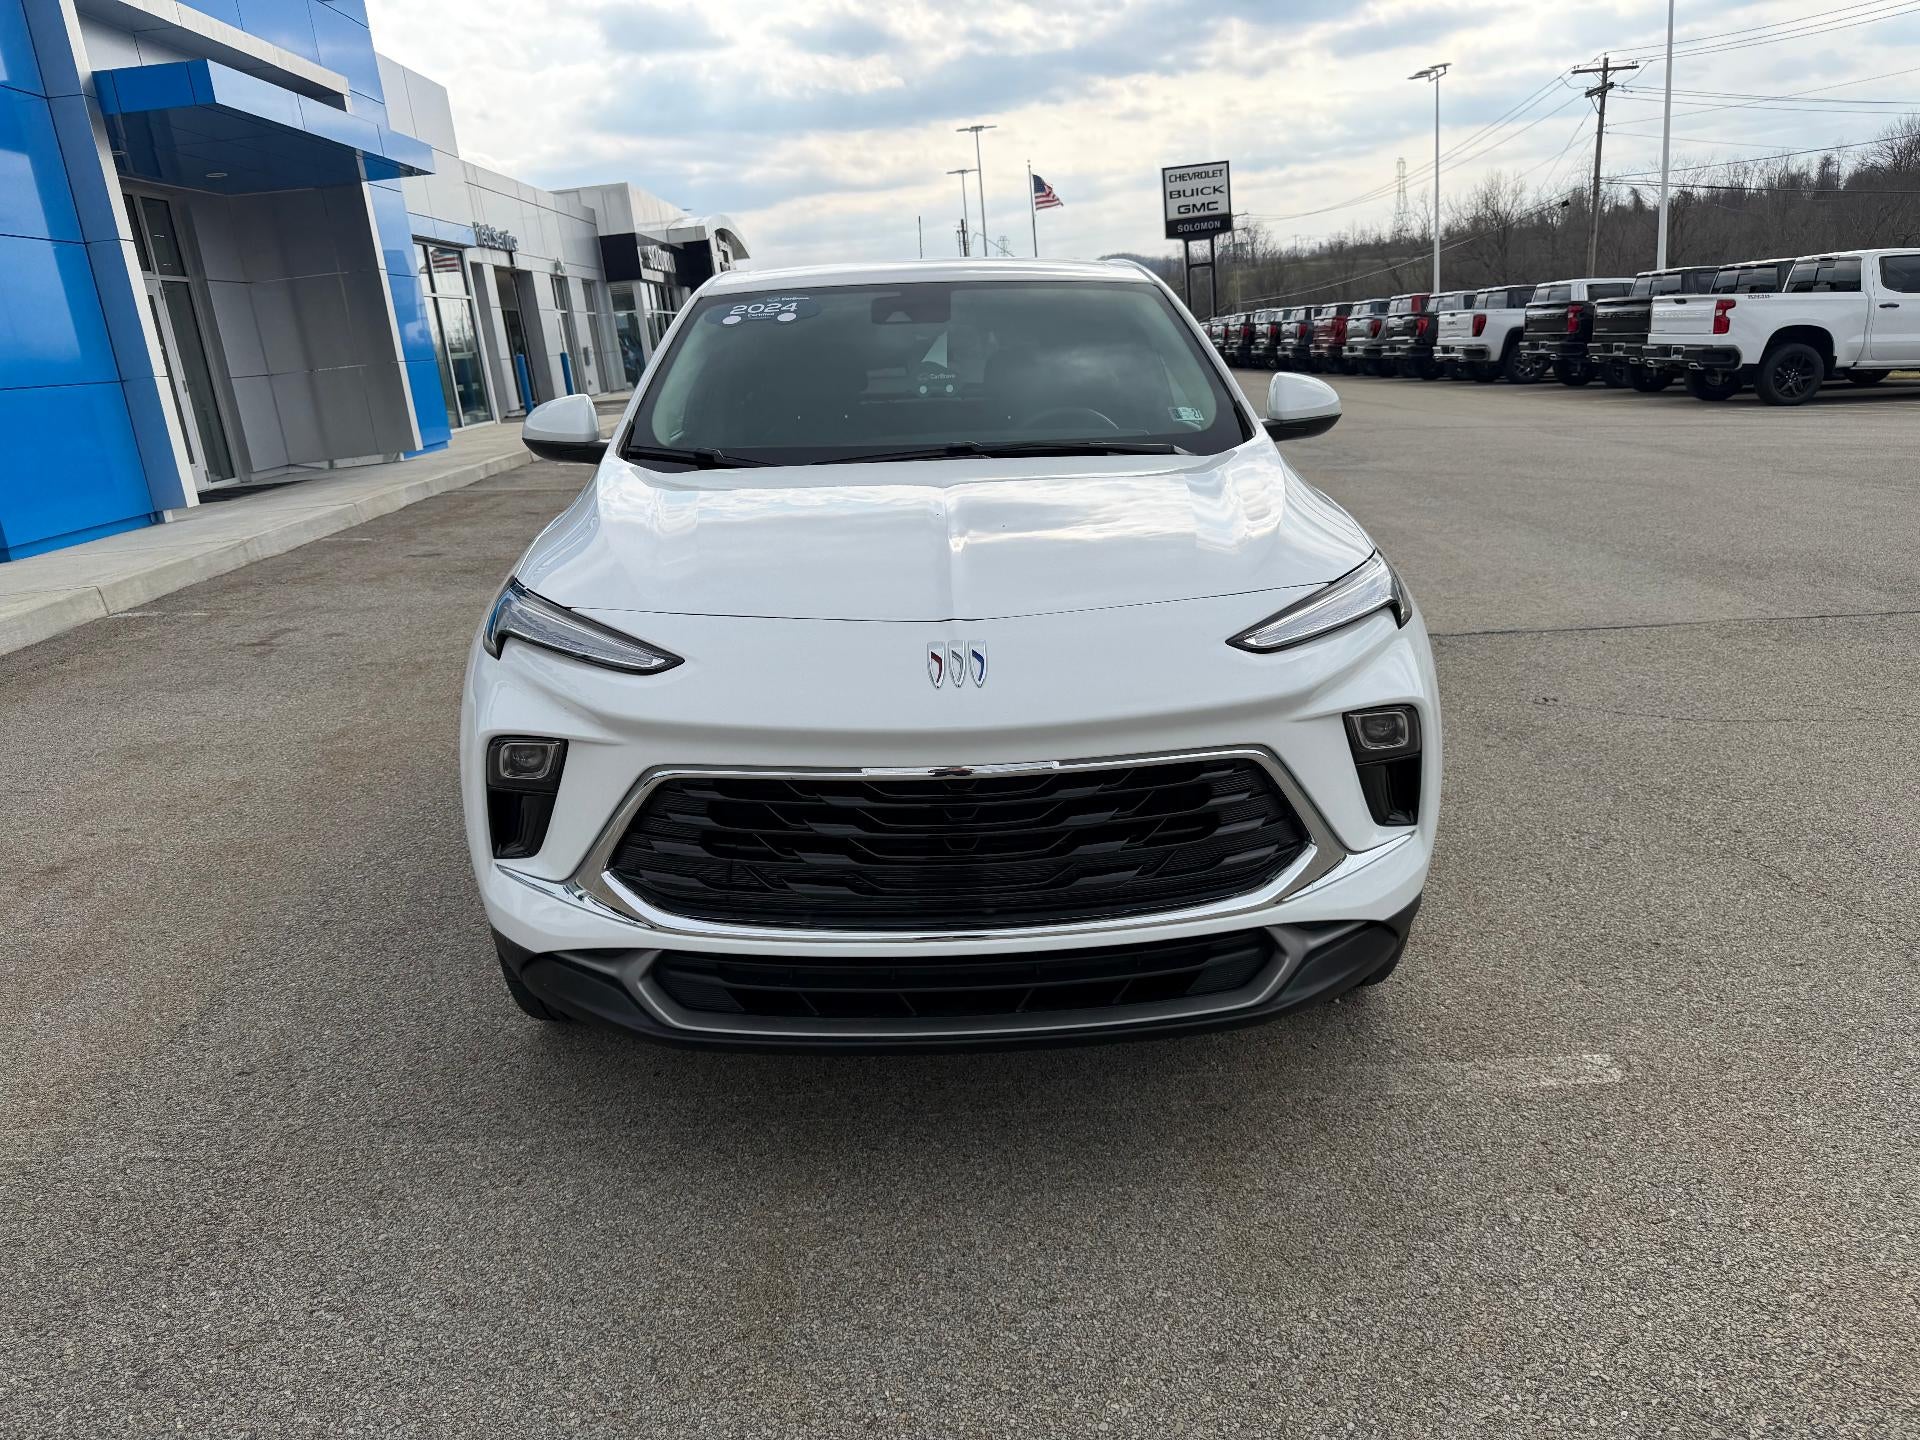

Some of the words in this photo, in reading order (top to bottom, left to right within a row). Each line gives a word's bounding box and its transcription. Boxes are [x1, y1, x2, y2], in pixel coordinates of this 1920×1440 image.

[1168, 169, 1224, 183] CHEVROLET
[1168, 185, 1225, 200] BUICK
[1177, 201, 1219, 215] GMC
[1177, 220, 1221, 233] SOLOMON
[729, 302, 798, 315] 2024
